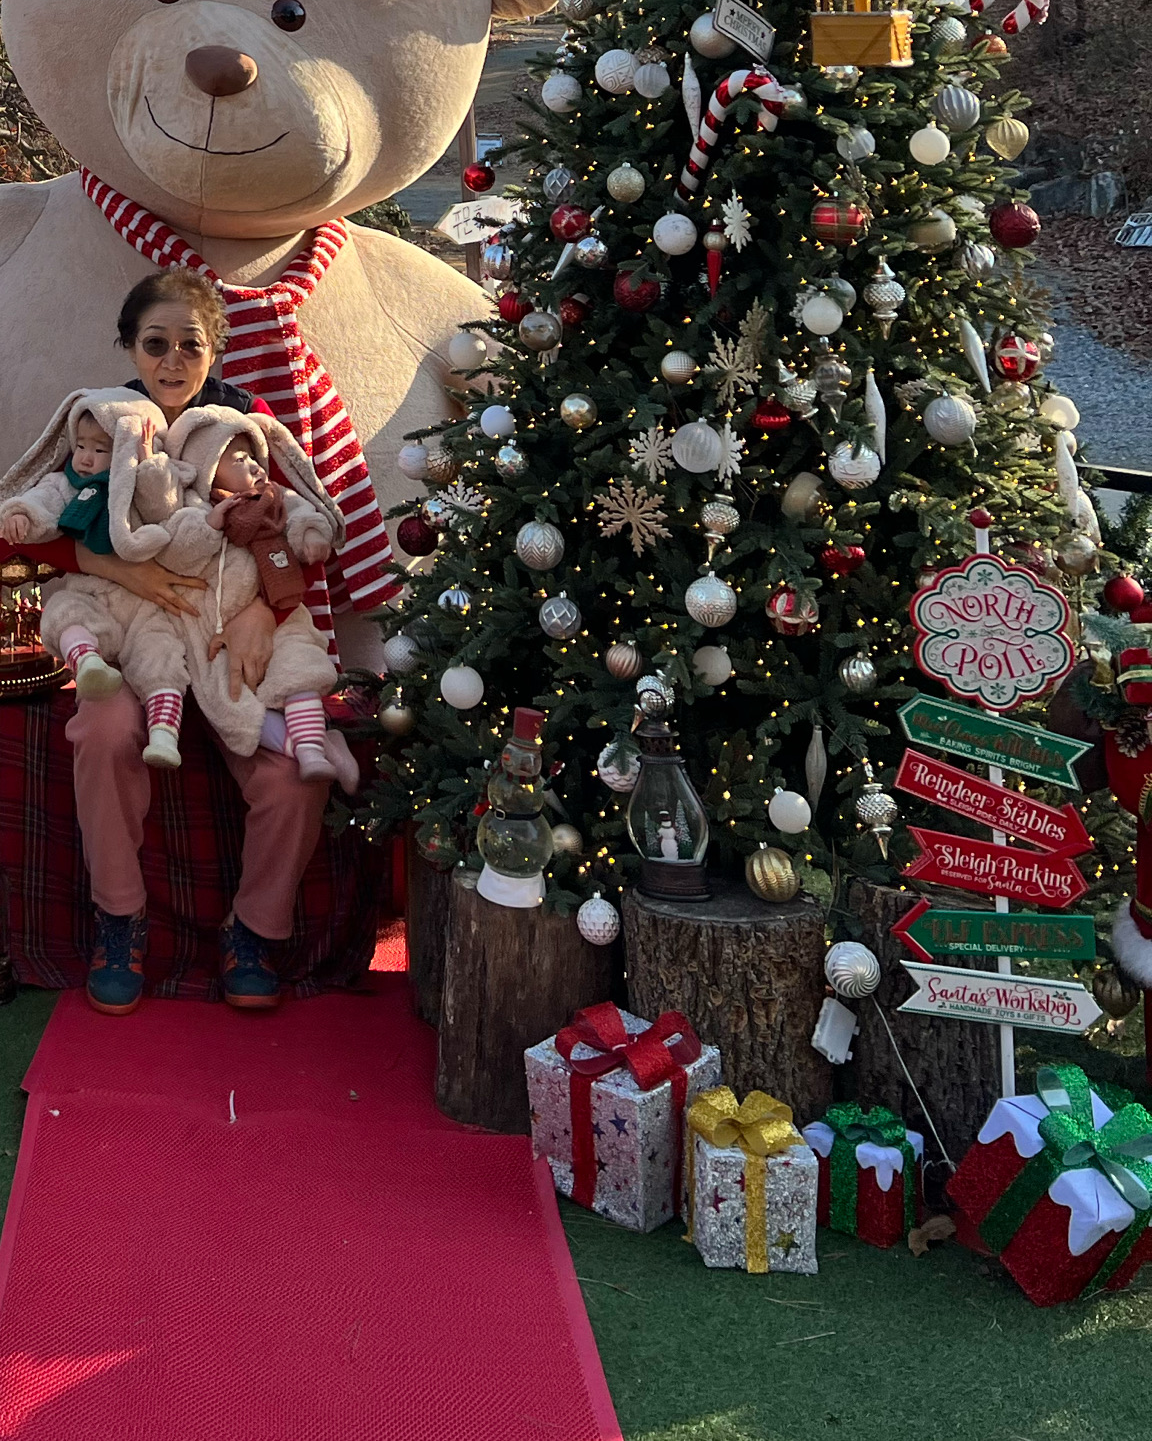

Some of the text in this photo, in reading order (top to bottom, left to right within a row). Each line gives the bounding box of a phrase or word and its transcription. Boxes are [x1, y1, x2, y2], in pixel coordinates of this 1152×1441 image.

[724, 15, 767, 53] CHRISTMAS
[736, 10, 762, 36] MERRY
[928, 585, 1037, 631] NORTH
[941, 635, 1046, 680] POLE
[939, 737, 1041, 773] BAKING SPIRITS BRIGHT
[909, 761, 1067, 841] Reindeer Stables
[949, 798, 1020, 831] SLEIGH RIDES DAILY
[934, 844, 1074, 898] Sleigh Parking
[940, 869, 1023, 894] RESERVED FOR Santa
[949, 942, 1025, 953] SPECIAL DELIVERY
[927, 976, 1081, 1026] Santa's Workshop
[949, 1003, 992, 1015] HANDMADE
[995, 1009, 1015, 1018] TOYS
[1023, 1013, 1046, 1022] GIFTS
